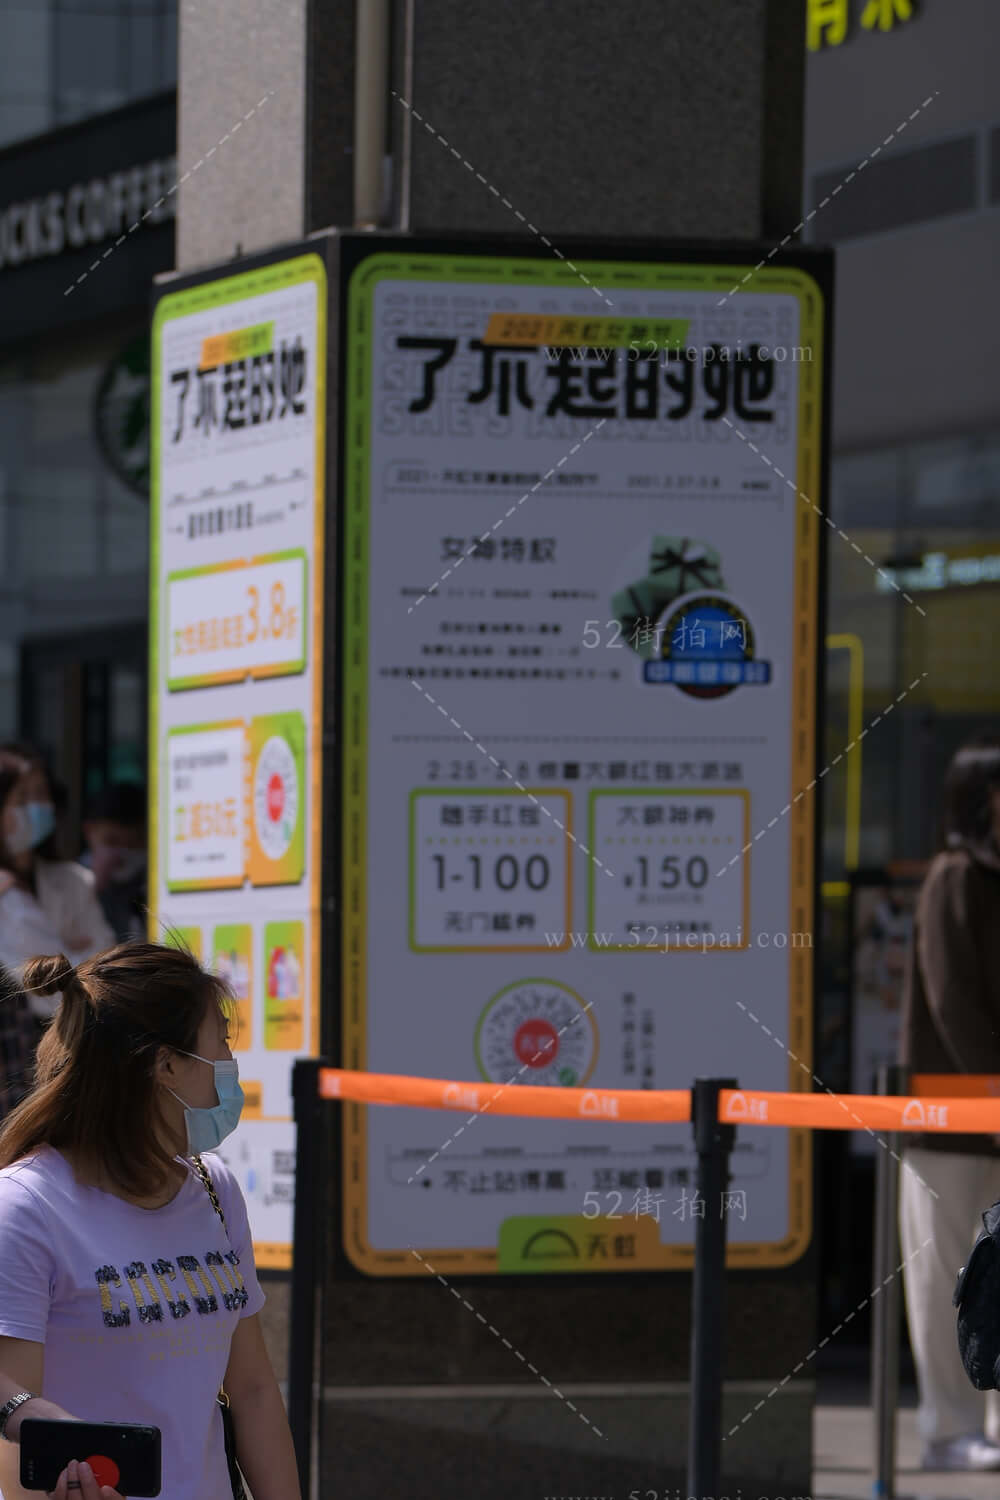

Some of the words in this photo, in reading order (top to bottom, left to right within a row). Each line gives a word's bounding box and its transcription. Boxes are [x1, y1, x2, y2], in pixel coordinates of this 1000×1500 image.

[395, 334, 776, 424] 了不起的她
[430, 854, 551, 892] 1-100
